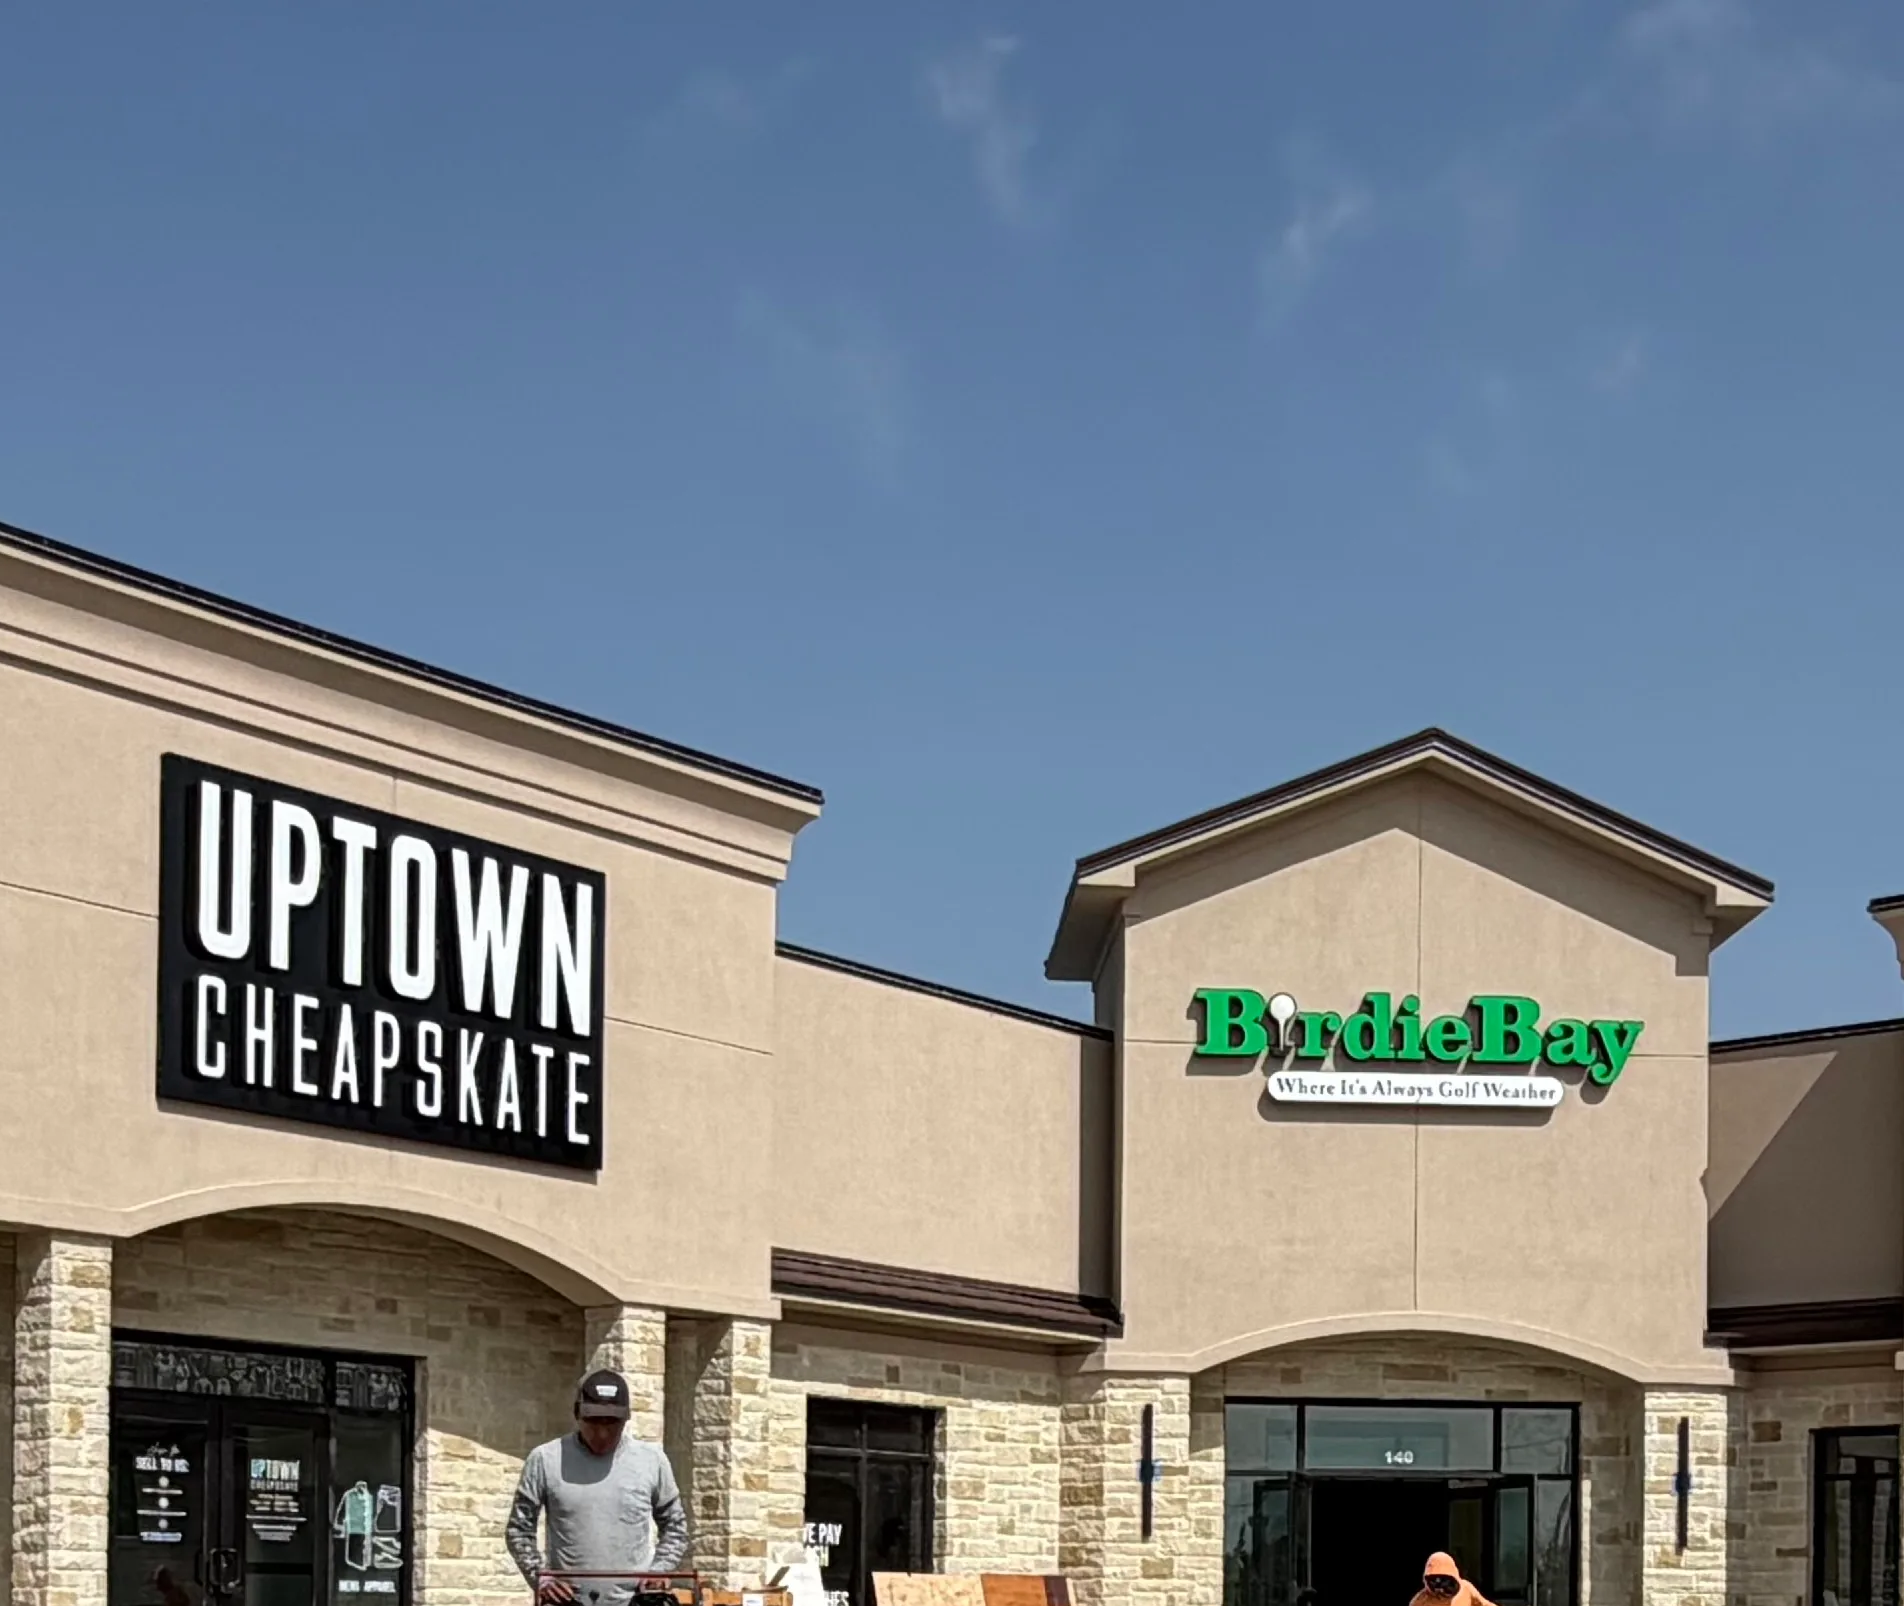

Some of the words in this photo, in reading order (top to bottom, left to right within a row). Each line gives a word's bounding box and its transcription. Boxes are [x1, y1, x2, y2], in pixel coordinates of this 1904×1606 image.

[197, 780, 594, 1038] UPTOWN
[196, 974, 592, 1146] CHEAPSKATE
[1195, 986, 1645, 1086] BirdieBay
[1276, 1077, 1336, 1096] Where
[1340, 1079, 1368, 1096] It's
[1372, 1080, 1434, 1102] Always
[1438, 1080, 1480, 1099] Golf
[1482, 1082, 1557, 1100] Weather
[1385, 1450, 1414, 1464] 140
[819, 1523, 842, 1545] PAY
